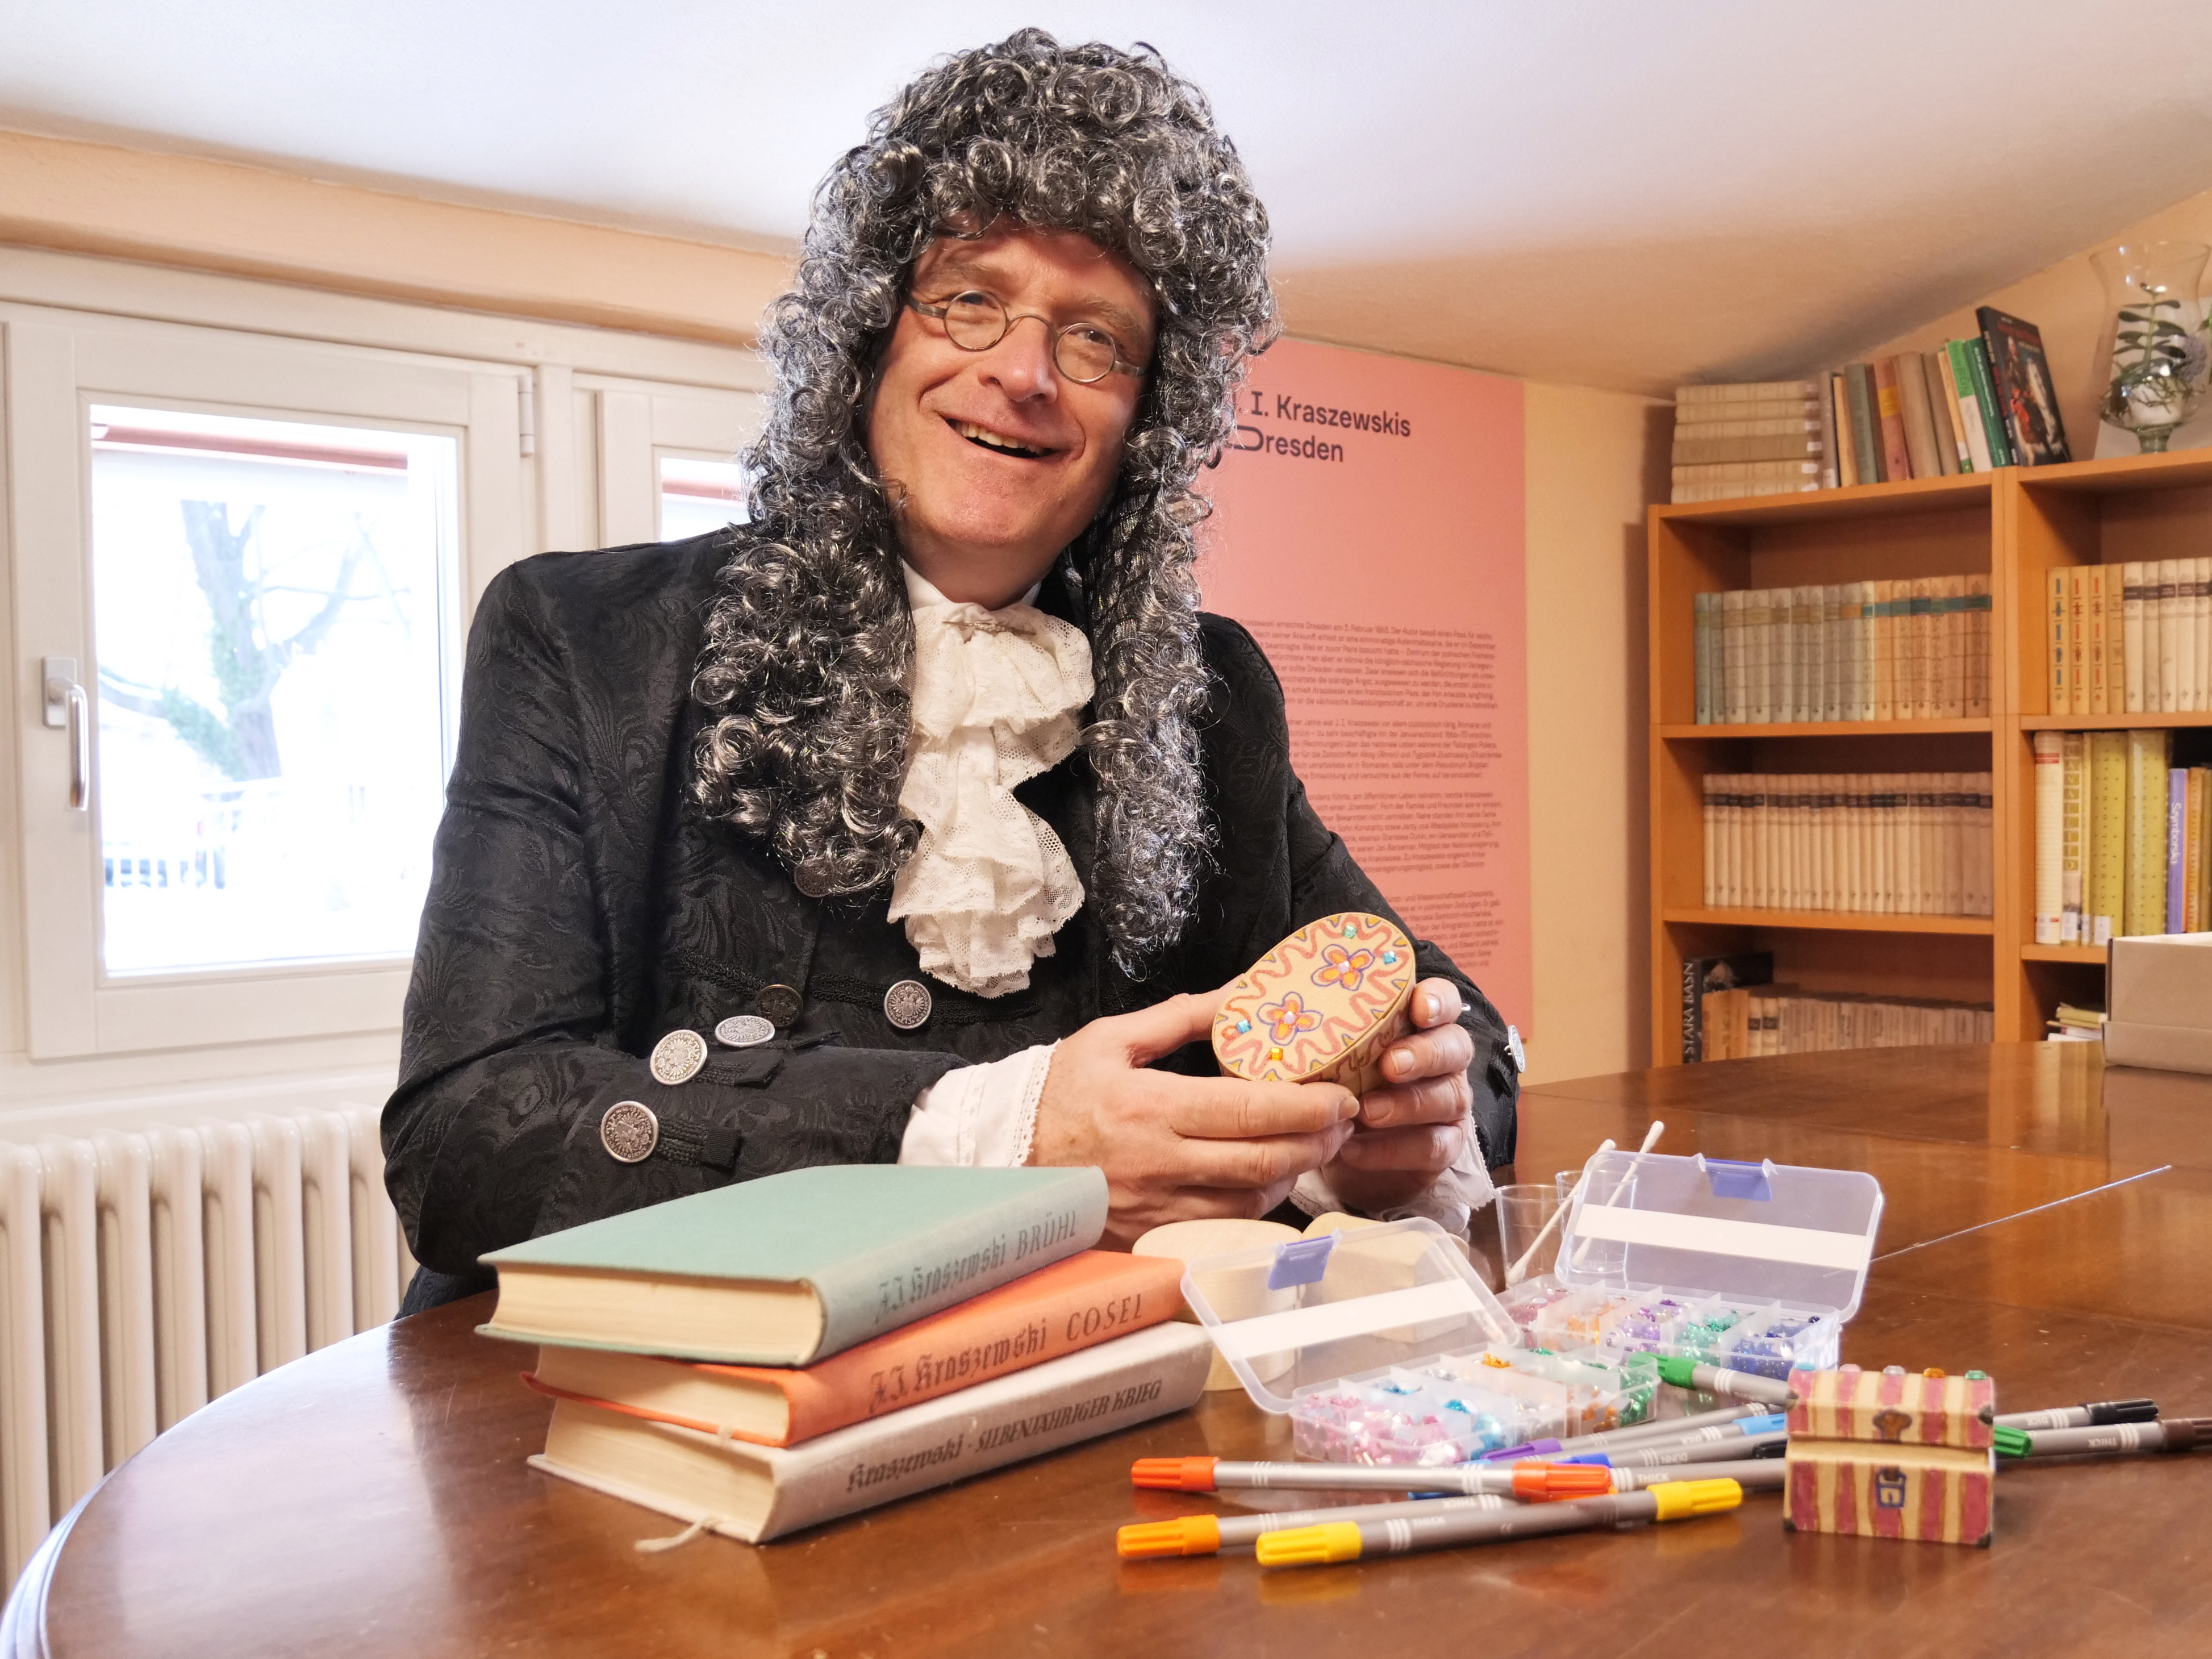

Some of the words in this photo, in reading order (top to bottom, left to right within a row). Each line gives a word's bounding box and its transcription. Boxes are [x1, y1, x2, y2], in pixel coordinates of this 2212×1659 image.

[1251, 390, 1268, 416] I.
[1277, 394, 1411, 437] Kraszewskis
[1226, 424, 1344, 463] Dresden
[1683, 1008, 1694, 1054] STARA
[1016, 1210, 1076, 1261] BRÜHL
[913, 1317, 1046, 1393] Kraszewski
[1065, 1293, 1142, 1342] COSEL
[846, 1433, 965, 1493] Kraszewski
[1111, 1379, 1162, 1412] KRIEG
[2026, 1416, 2048, 1427] DICK
[2088, 1437, 2118, 1448] THICK
[1637, 1472, 1669, 1483] THICK
